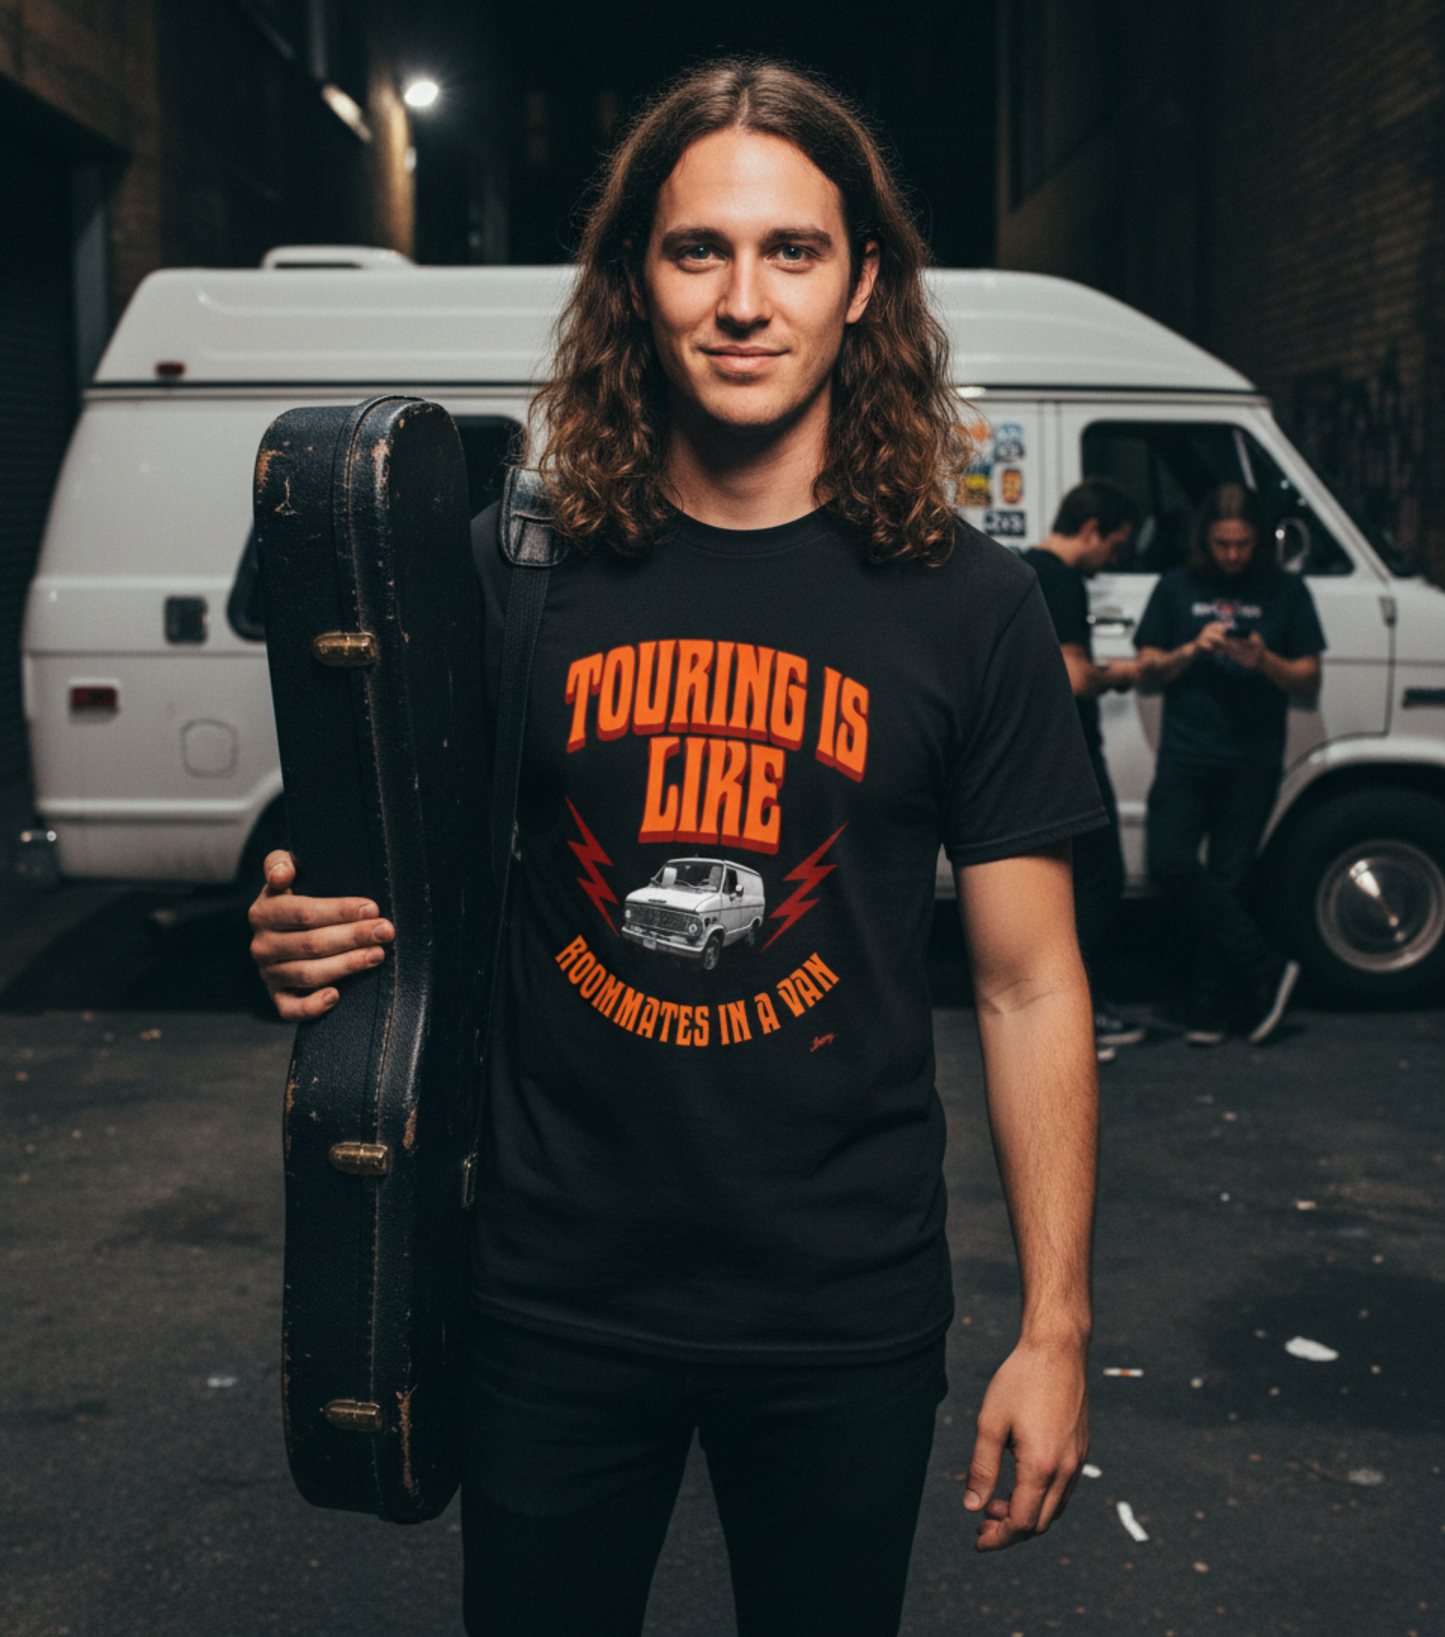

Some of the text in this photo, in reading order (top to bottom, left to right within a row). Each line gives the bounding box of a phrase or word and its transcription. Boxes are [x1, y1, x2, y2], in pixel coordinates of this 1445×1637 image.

[564, 639, 870, 783] TOURING IS
[638, 736, 785, 855] LIKE
[555, 934, 840, 1047] ROOMMATES IN A VAN
